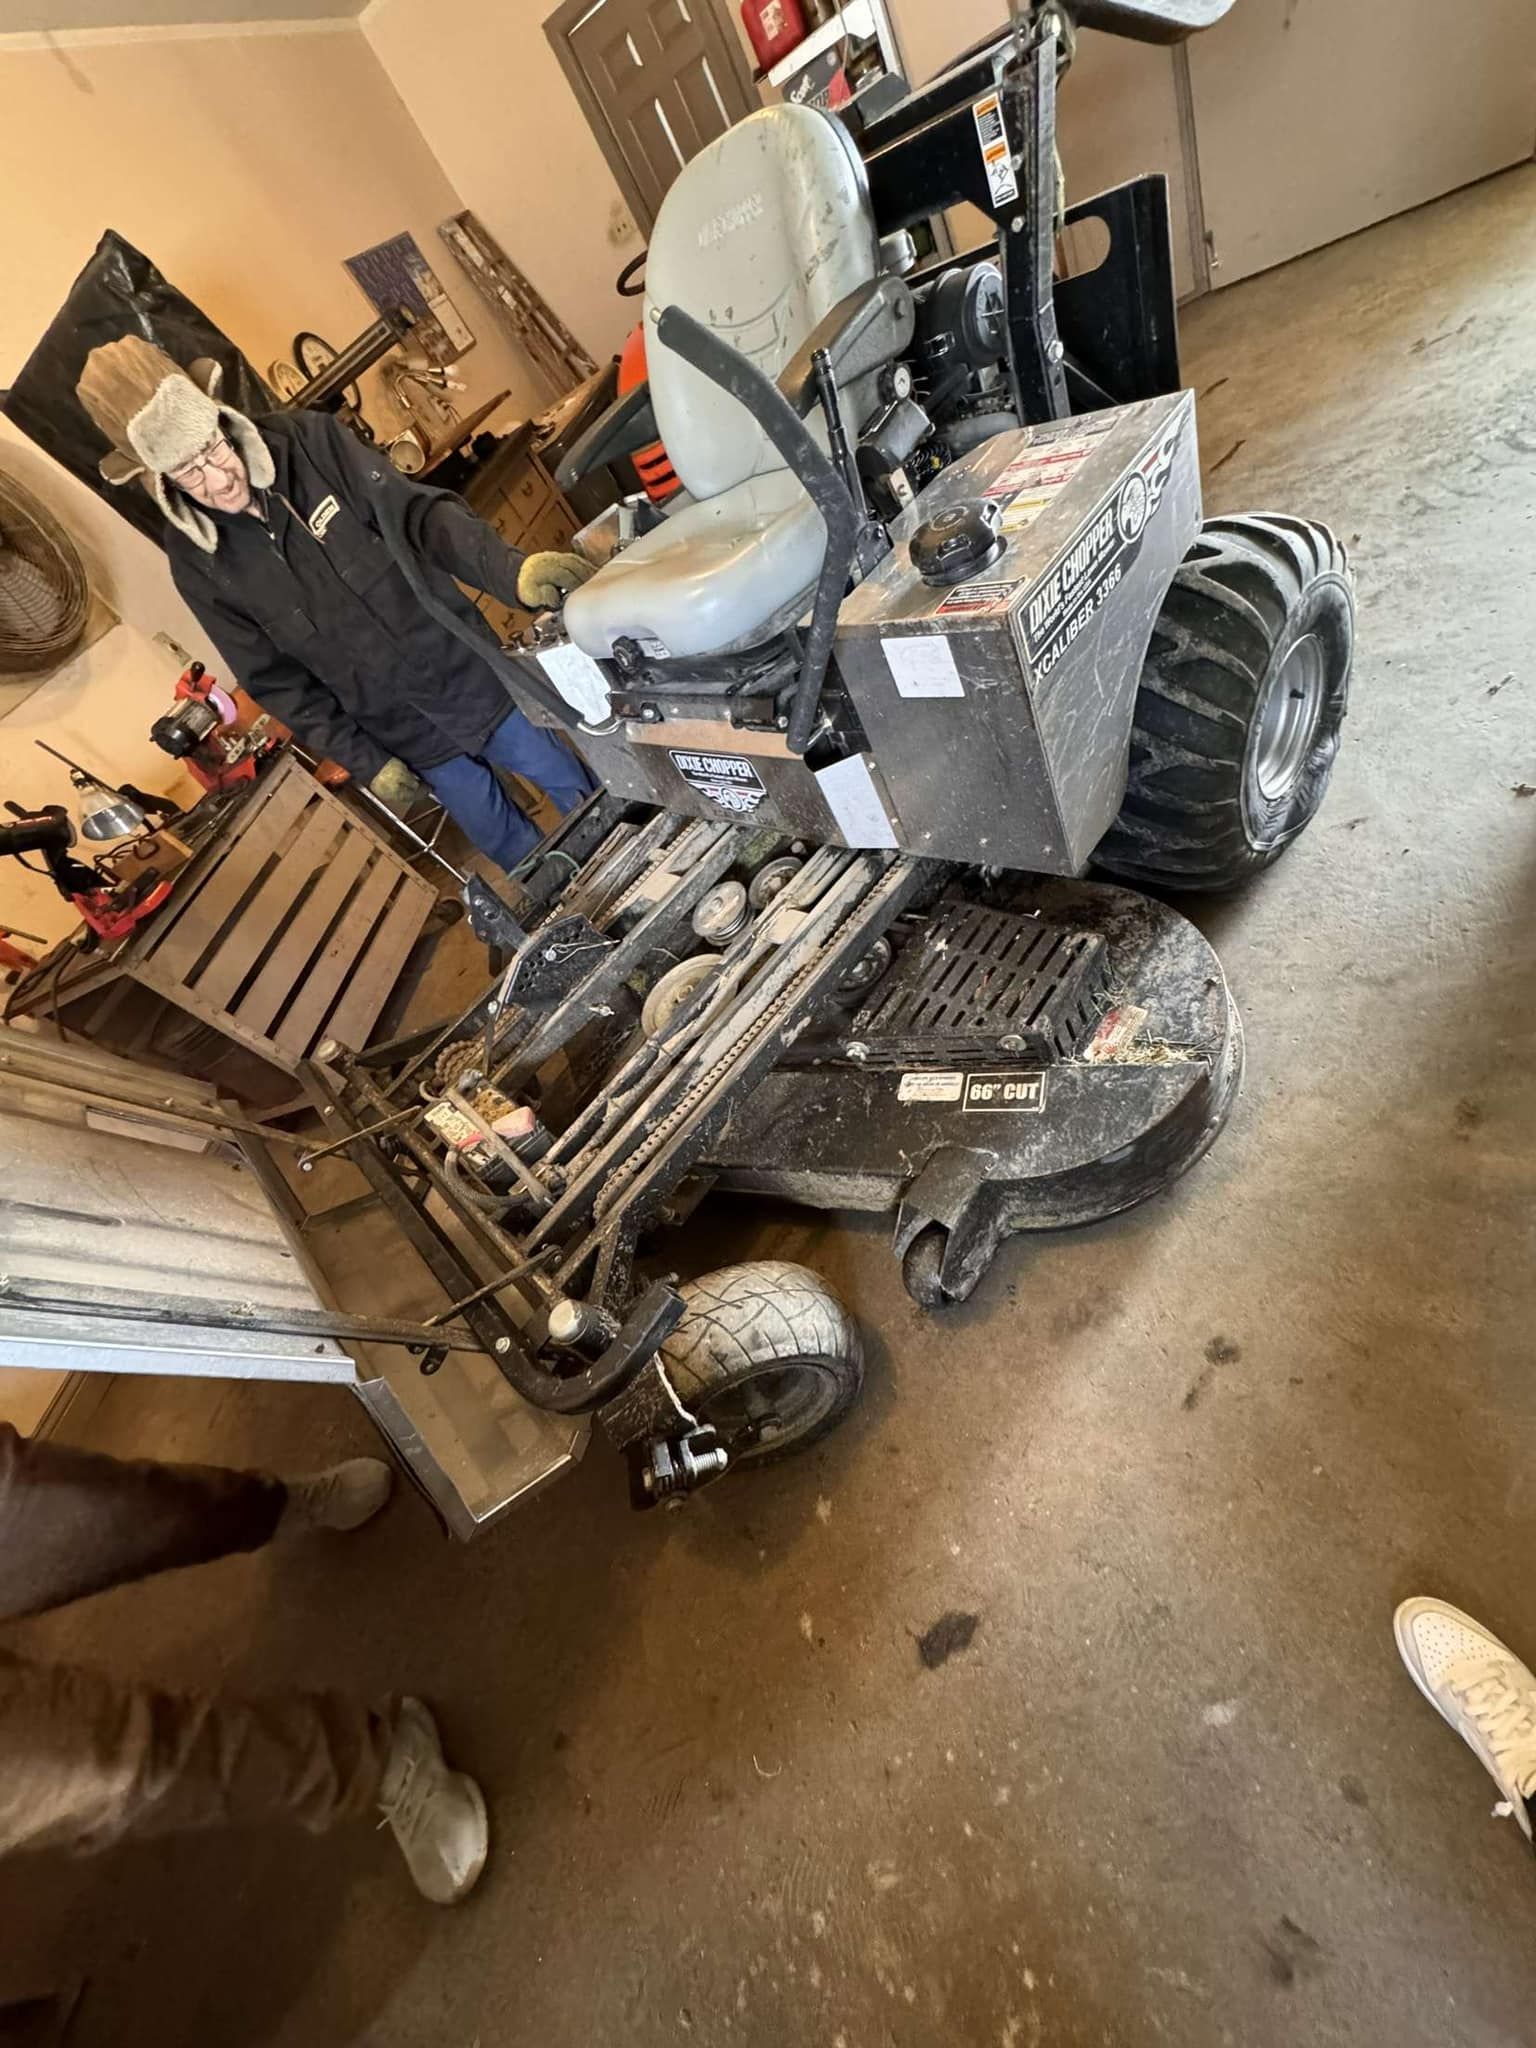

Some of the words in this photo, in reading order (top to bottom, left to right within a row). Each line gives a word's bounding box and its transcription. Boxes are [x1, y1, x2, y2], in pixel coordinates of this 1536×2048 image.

[1030, 571, 1061, 634] DIXIE
[1062, 508, 1114, 591] CHOPPER
[1034, 598, 1094, 684] XCALIBER
[1096, 563, 1121, 605] 3366
[674, 754, 704, 771] DIXIE
[702, 757, 753, 778] CHOPPER
[970, 1083, 1001, 1100] 66"
[1003, 1082, 1039, 1100] CUT
